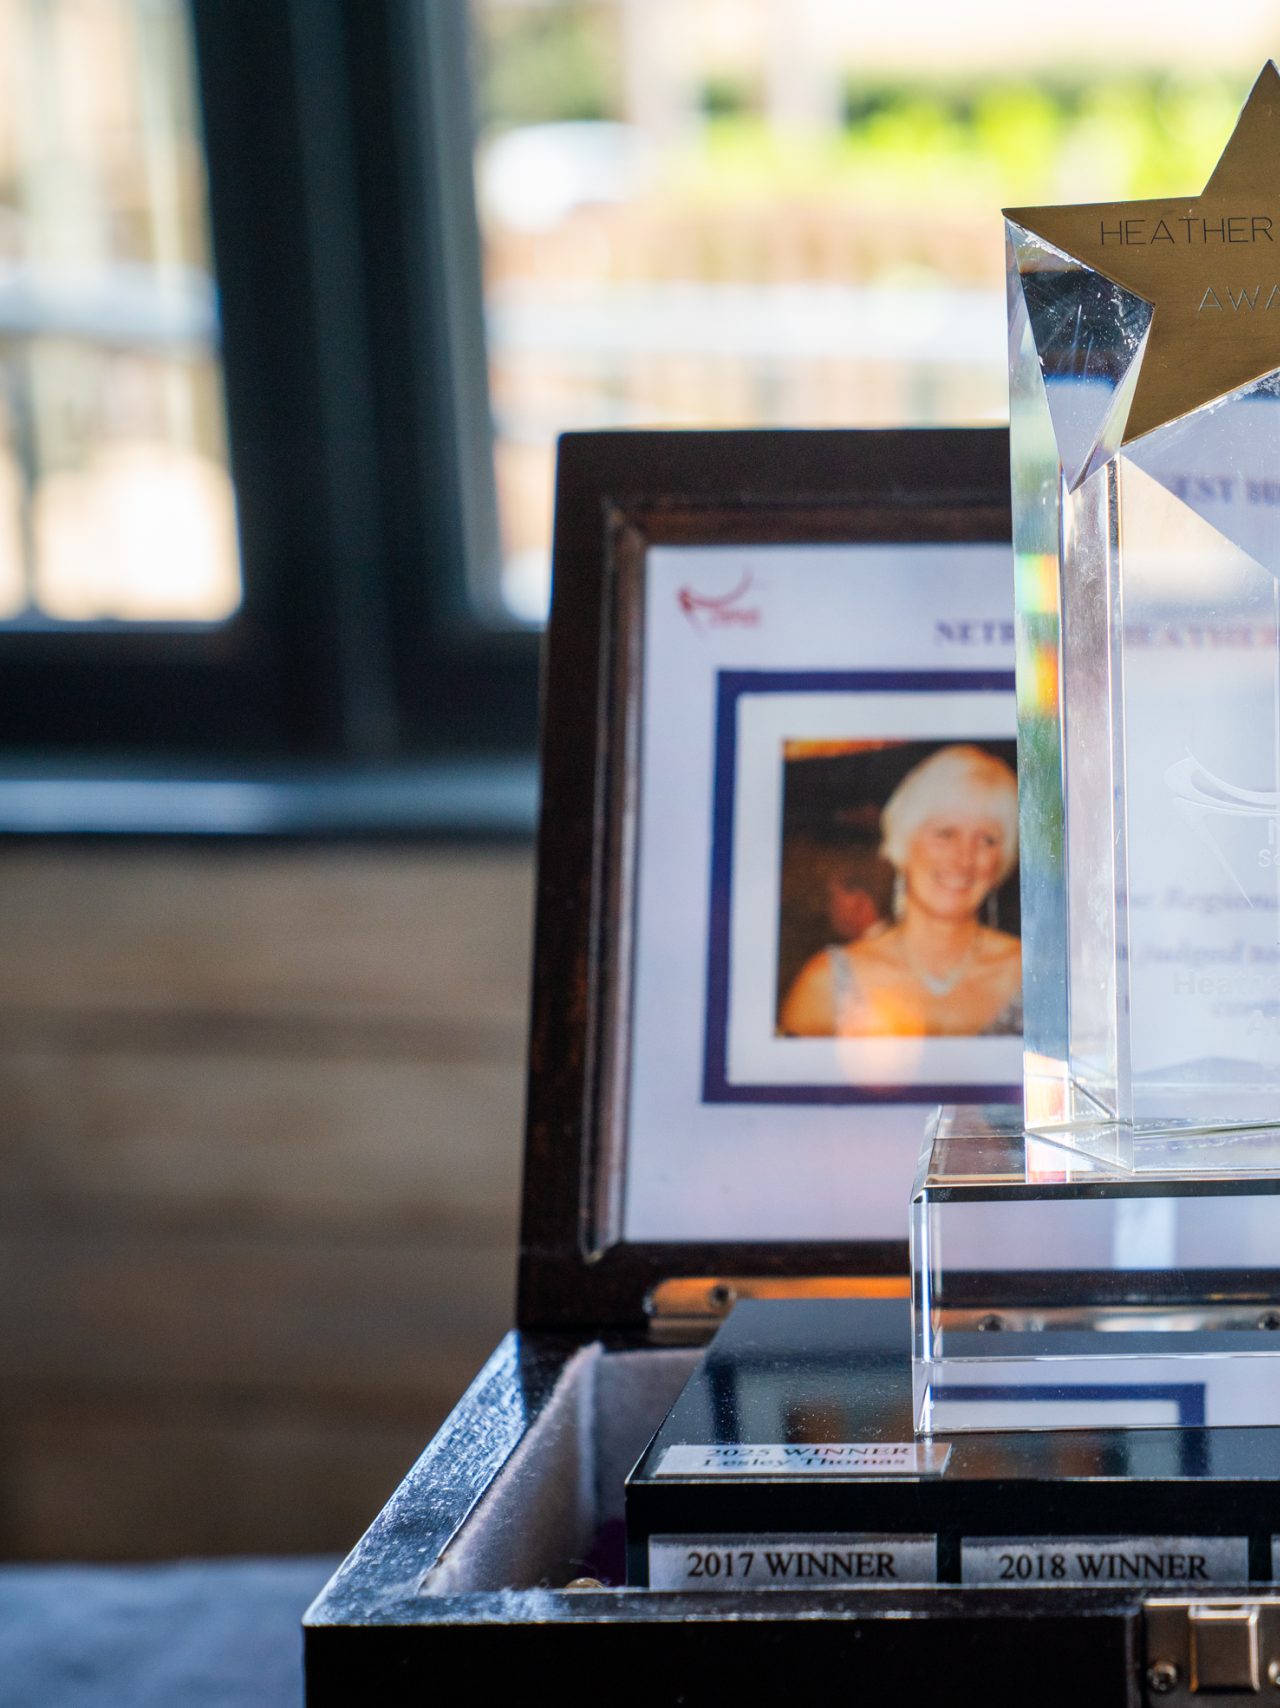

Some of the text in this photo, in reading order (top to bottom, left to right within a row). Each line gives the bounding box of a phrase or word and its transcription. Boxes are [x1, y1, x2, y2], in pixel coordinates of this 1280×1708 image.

[1100, 216, 1275, 246] HEATHER
[783, 1447, 911, 1457] WINNER
[801, 1457, 906, 1466] Thomas
[687, 1552, 897, 1578] 2017 WINNER
[999, 1554, 1210, 1581] 2018 WINNER
